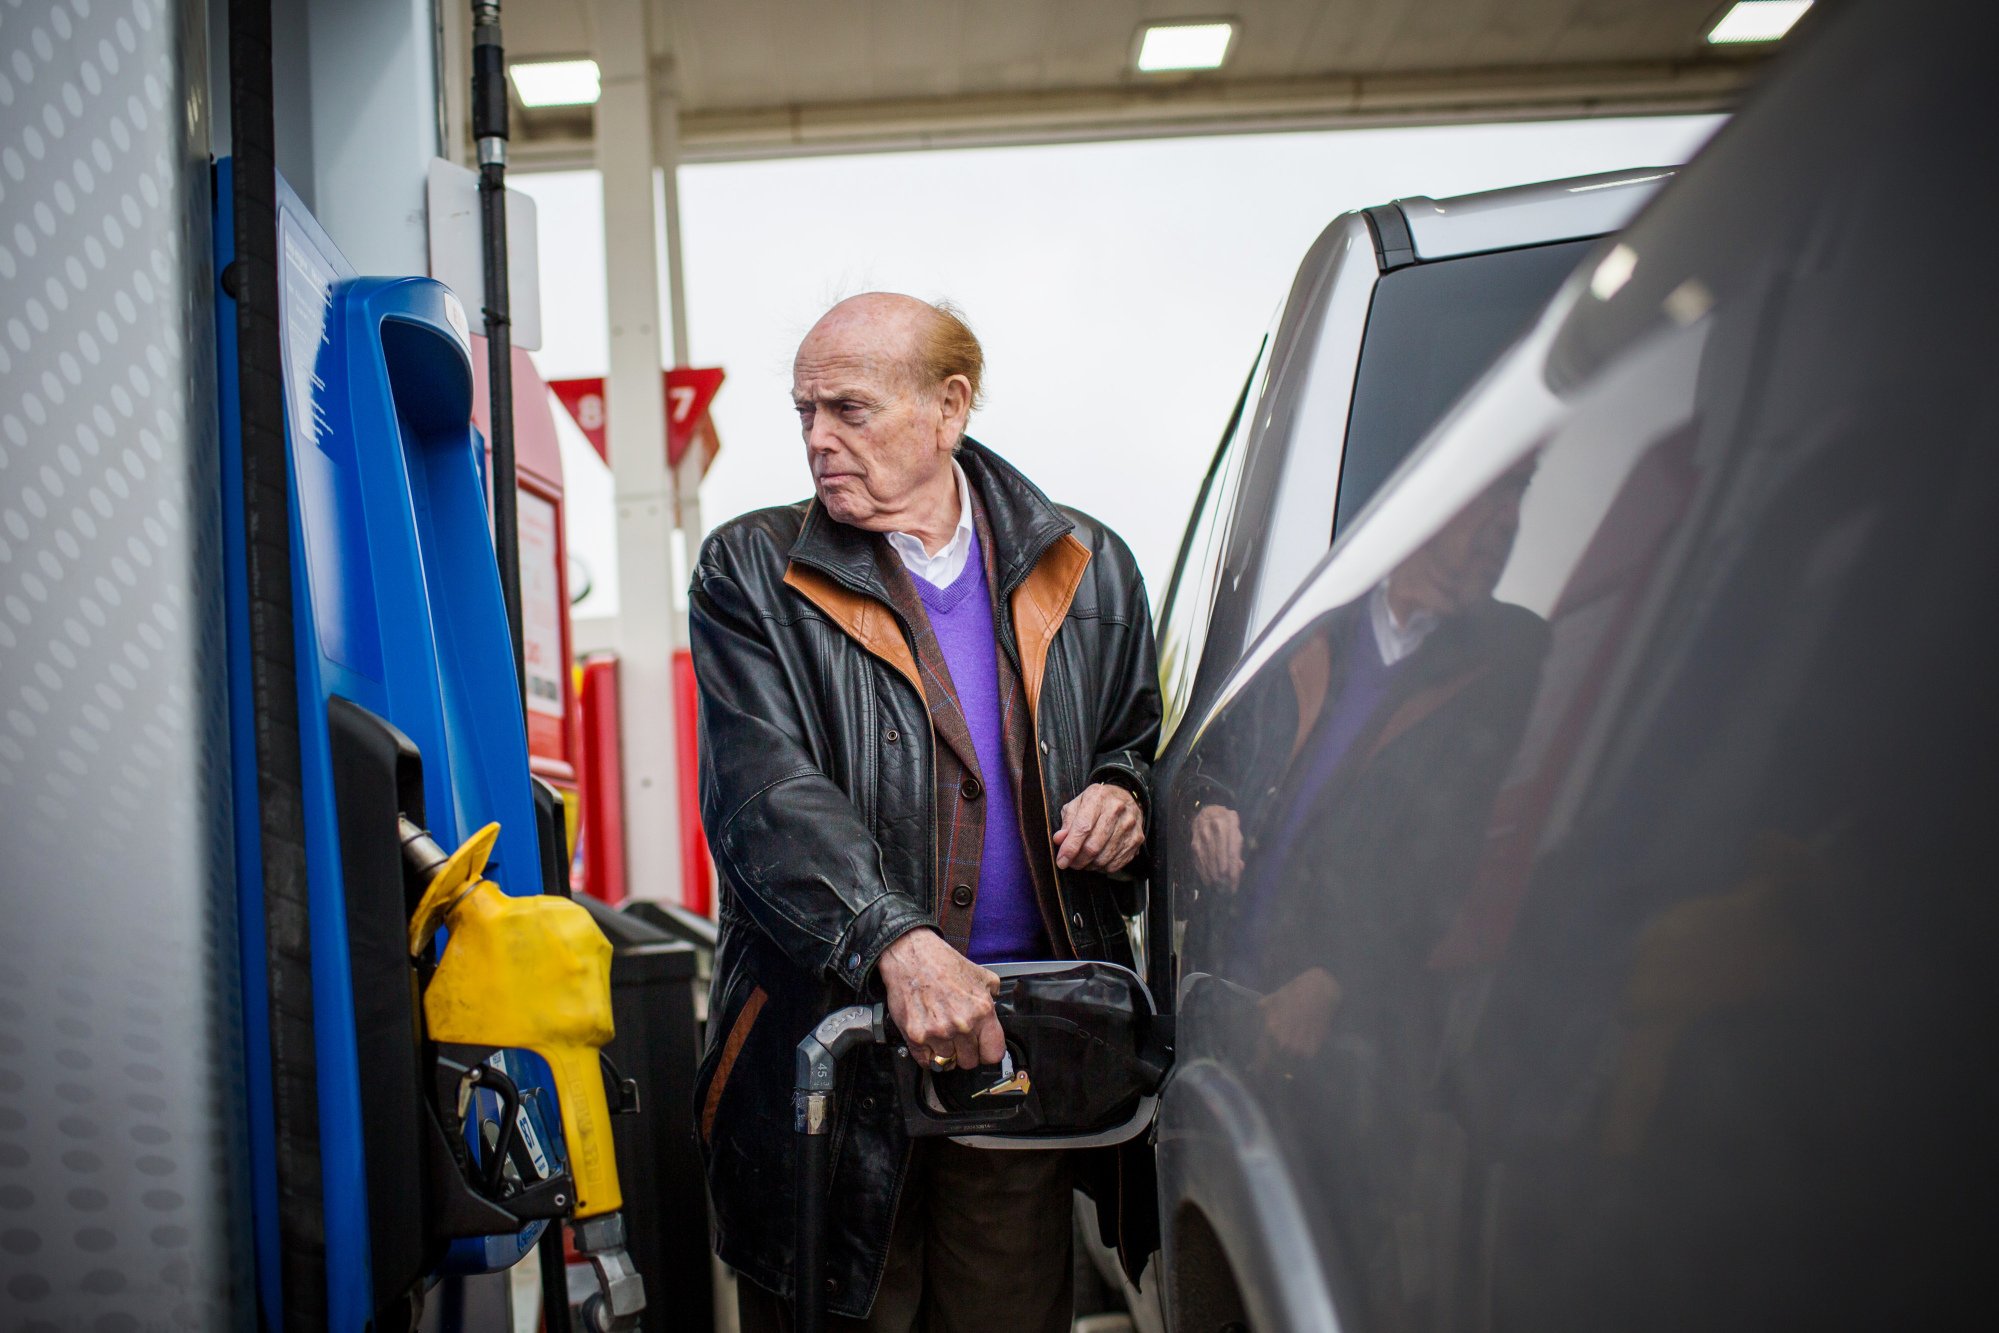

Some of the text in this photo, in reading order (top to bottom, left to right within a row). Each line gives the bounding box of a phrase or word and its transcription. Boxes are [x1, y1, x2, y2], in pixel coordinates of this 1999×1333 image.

[578, 394, 603, 430] 8
[669, 387, 696, 422] 7
[818, 1063, 828, 1078] 45
